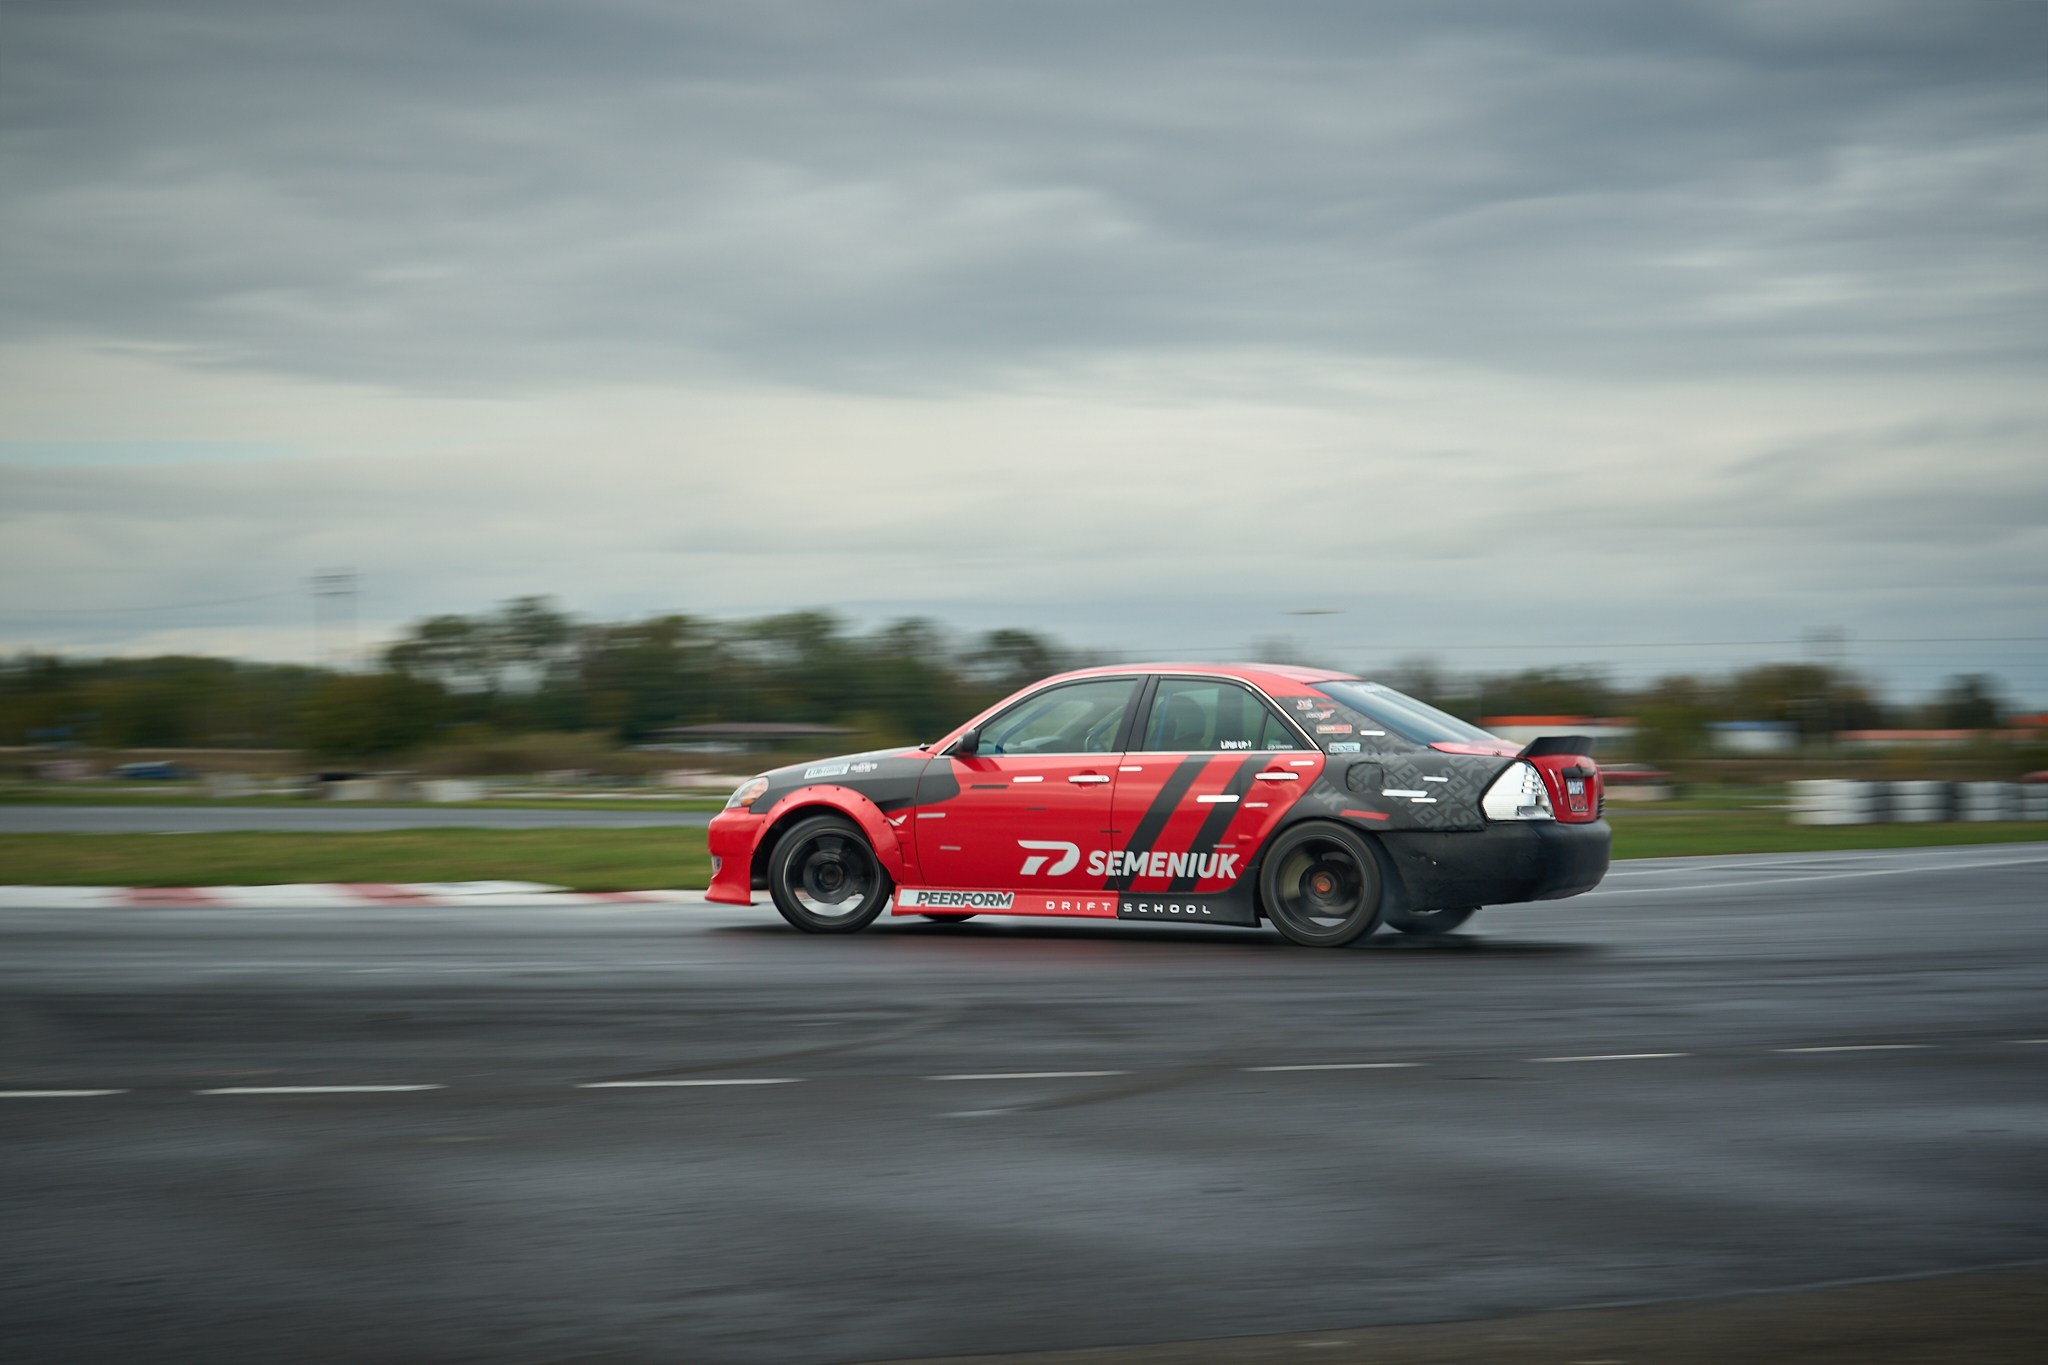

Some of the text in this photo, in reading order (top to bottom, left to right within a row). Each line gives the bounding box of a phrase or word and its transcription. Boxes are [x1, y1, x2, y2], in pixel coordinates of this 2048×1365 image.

[1086, 850, 1240, 879] SEMENIUK
[915, 891, 1014, 908] PEERFORM
[1046, 900, 1212, 914] DRIFT SCHOOL
